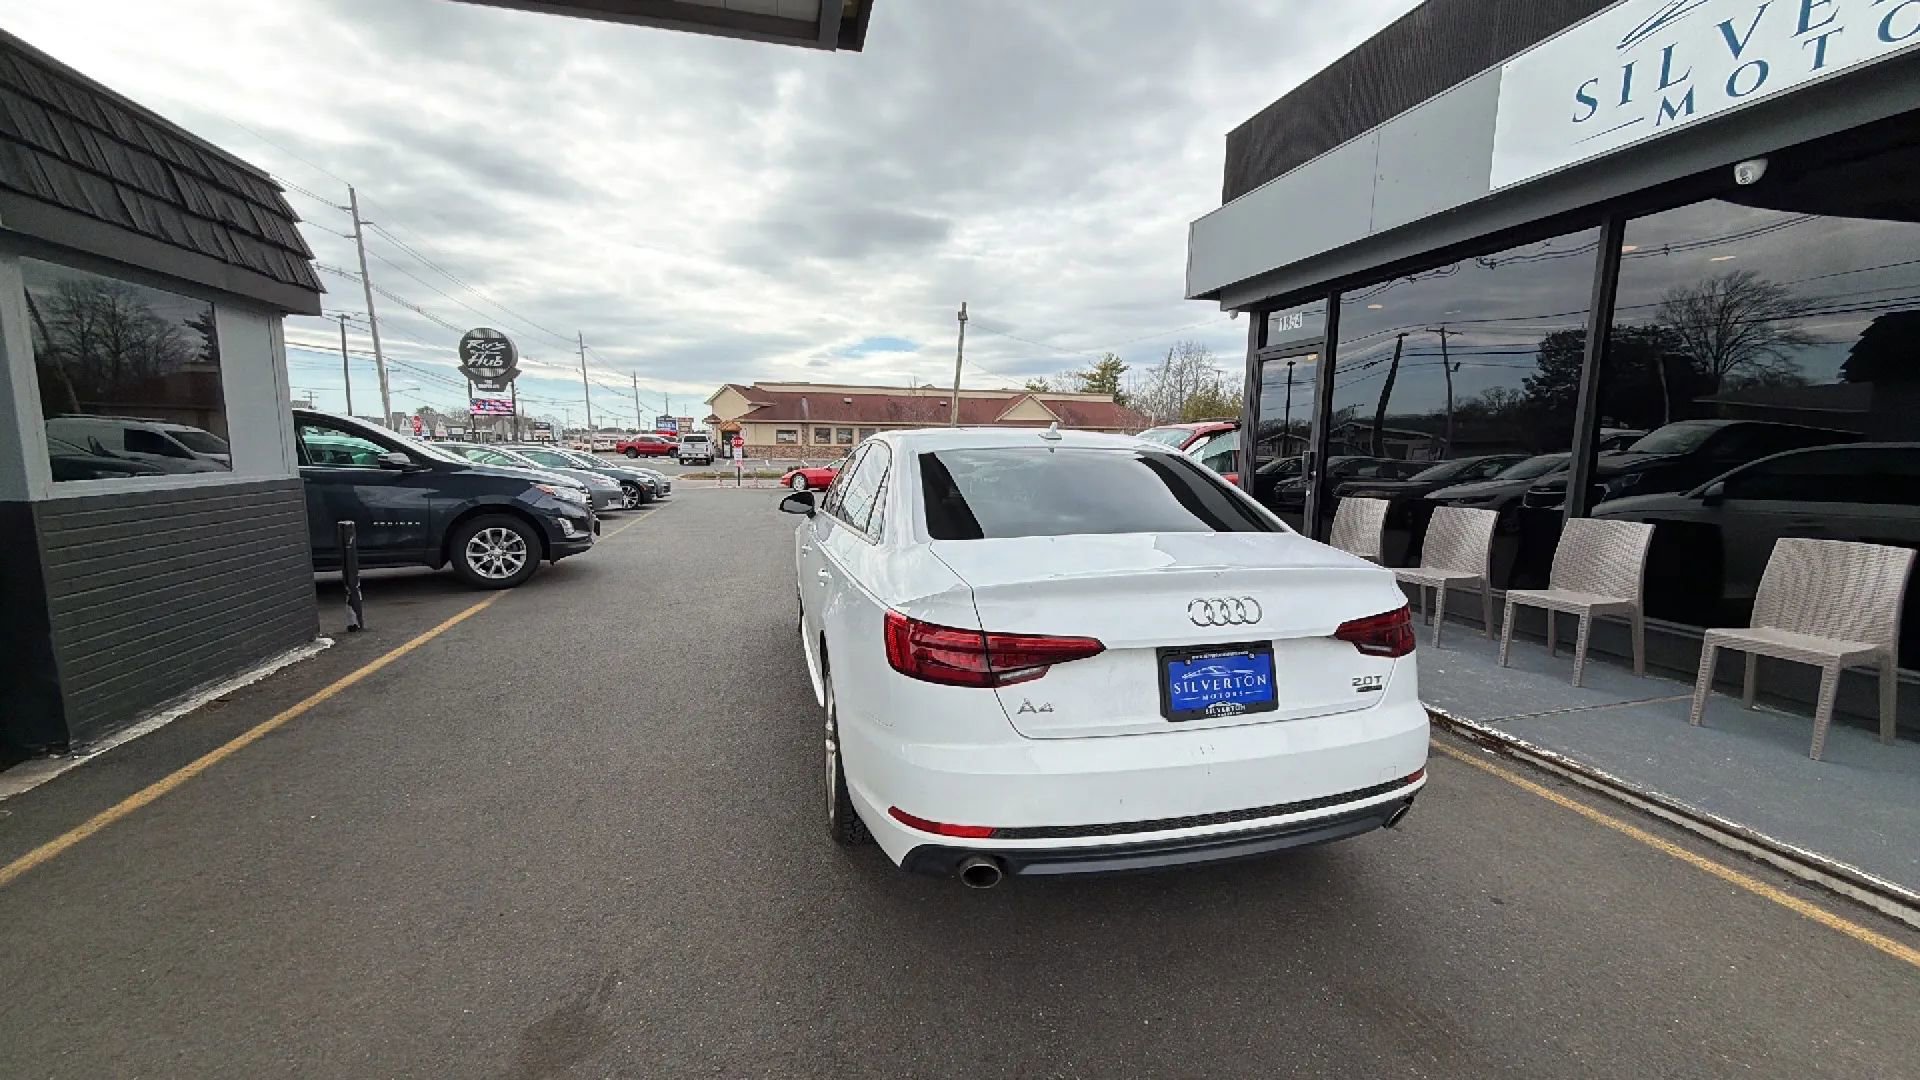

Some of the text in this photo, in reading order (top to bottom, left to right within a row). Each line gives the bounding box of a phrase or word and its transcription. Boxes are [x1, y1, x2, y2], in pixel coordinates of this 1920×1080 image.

[1572, 0, 1885, 122] SILVE
[1173, 674, 1267, 694] SILVERTON
[1017, 698, 1054, 714] A4
